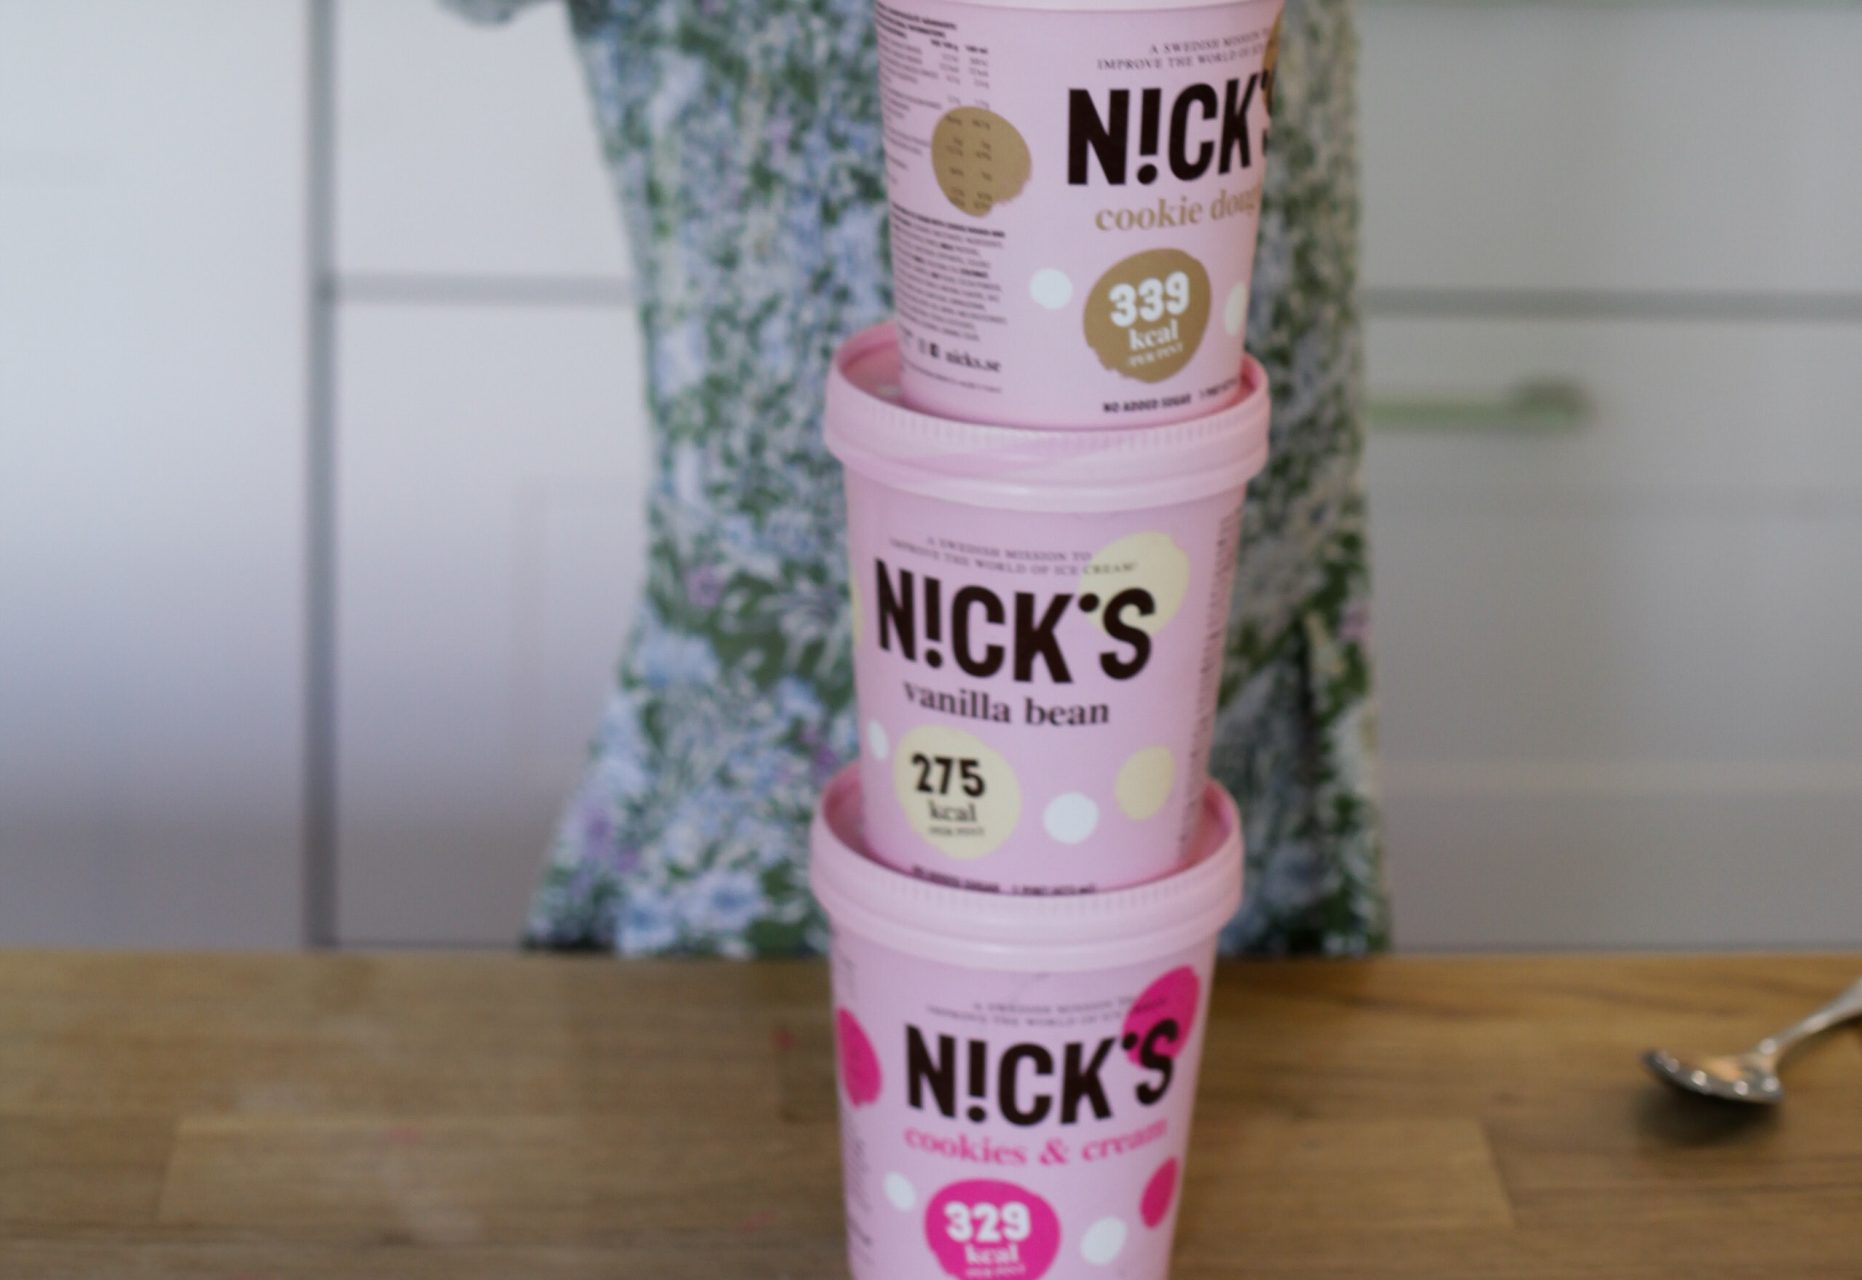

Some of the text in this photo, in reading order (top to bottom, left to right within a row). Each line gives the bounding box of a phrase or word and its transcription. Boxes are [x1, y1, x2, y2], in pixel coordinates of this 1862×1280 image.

[1097, 58, 1162, 70] IMPROVE
[1068, 68, 1270, 186] N!CK'
[1094, 195, 1203, 232] cookie
[1108, 271, 1190, 328] 339
[1128, 317, 1180, 351] kcal
[875, 557, 1157, 684] N!CK'S
[902, 680, 1110, 727] vanilla bean
[911, 752, 986, 798] 275
[928, 799, 978, 822] kcal
[905, 1018, 1179, 1127] N!CK'S
[903, 1120, 1169, 1166] cookies & cream
[944, 1200, 1032, 1242] 329
[965, 1241, 1019, 1264] kcal
